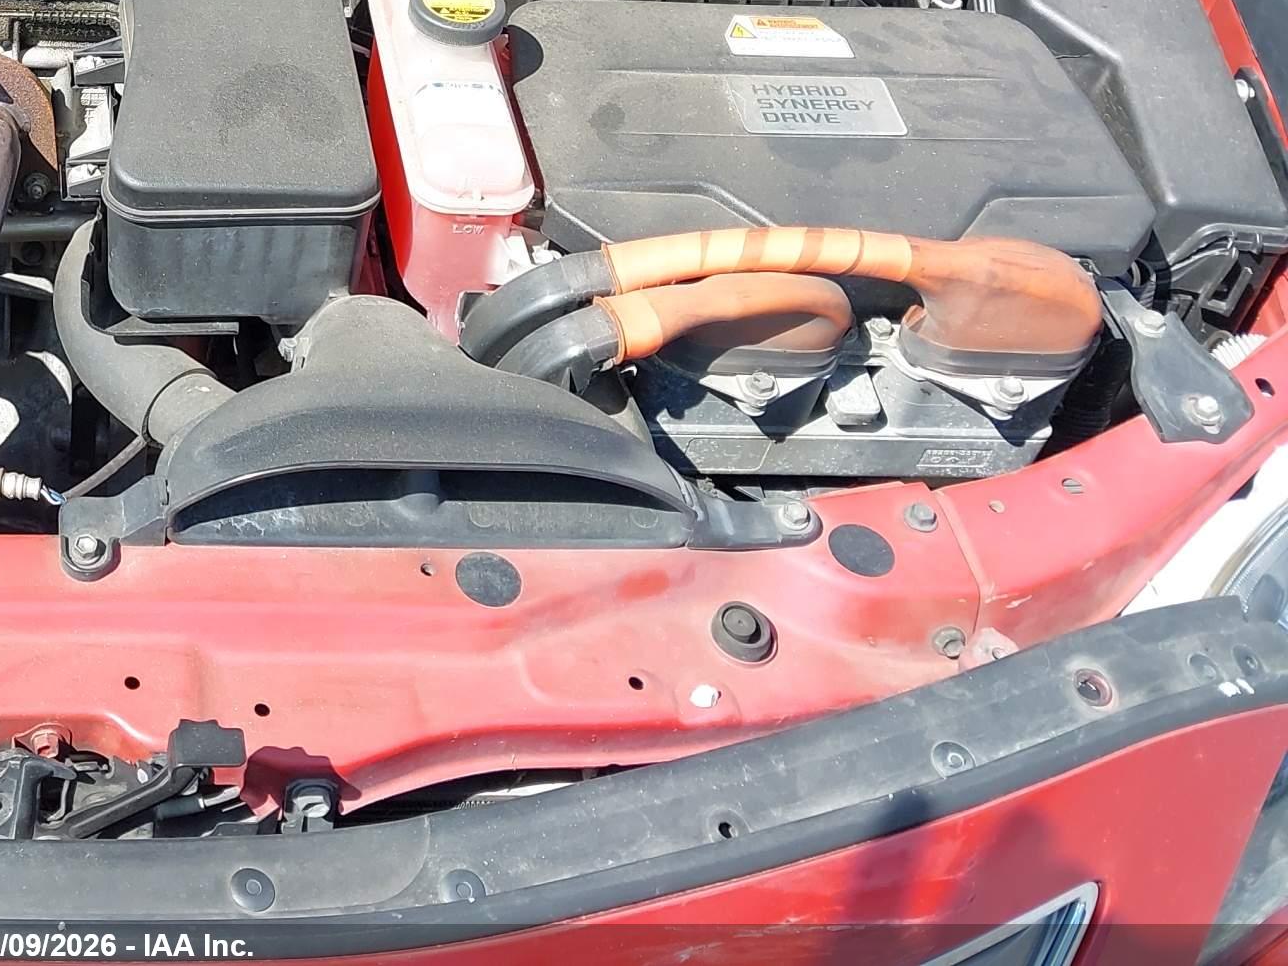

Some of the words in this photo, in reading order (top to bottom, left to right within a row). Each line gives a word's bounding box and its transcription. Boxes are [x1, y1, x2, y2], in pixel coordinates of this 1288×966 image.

[751, 84, 847, 97] HYBRID
[756, 98, 875, 111] SYNERGY
[762, 112, 841, 124] DRIVE
[452, 225, 484, 235] LOW
